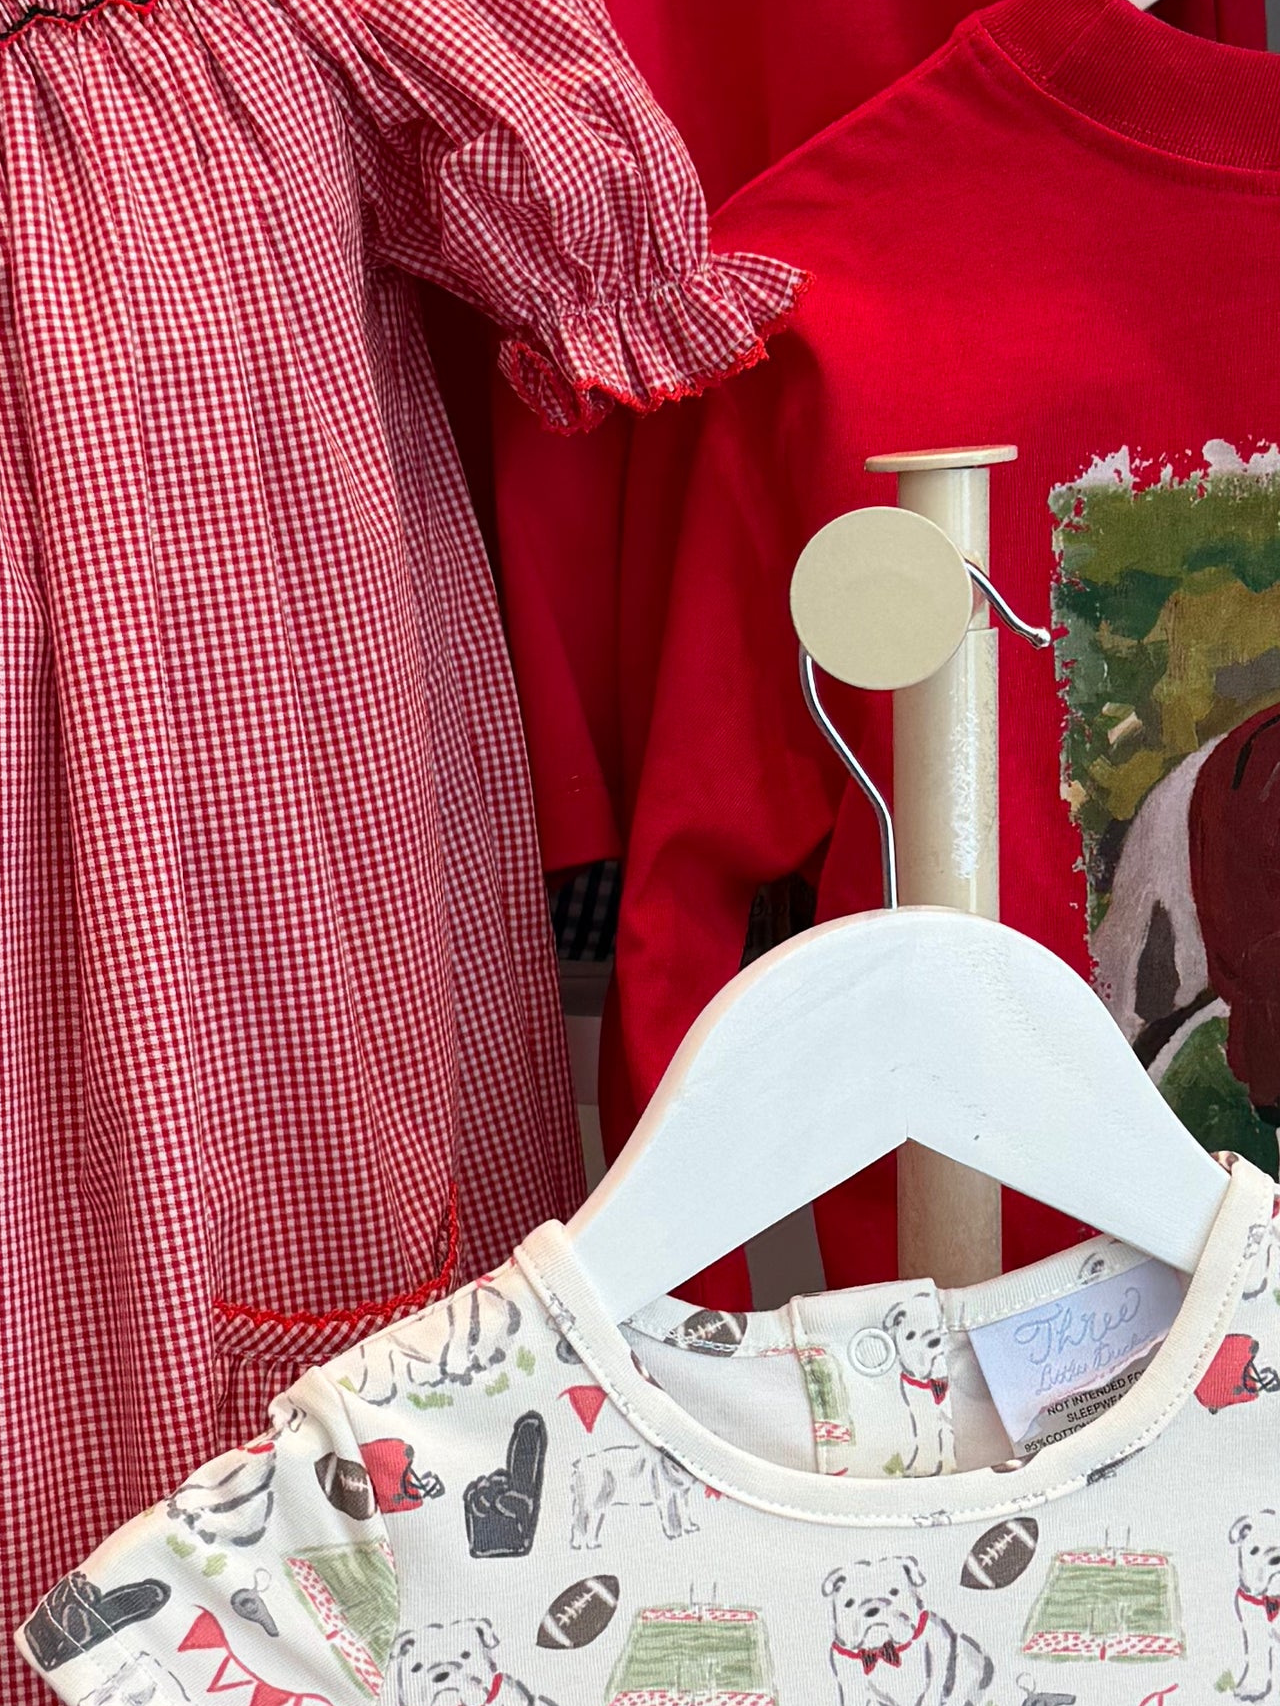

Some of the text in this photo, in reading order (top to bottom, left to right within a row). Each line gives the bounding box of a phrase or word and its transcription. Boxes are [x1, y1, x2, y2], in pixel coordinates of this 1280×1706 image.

[1014, 1286, 1141, 1366] Three
[1047, 1399, 1070, 1416] NOT
[1072, 1378, 1126, 1406] INTENDED
